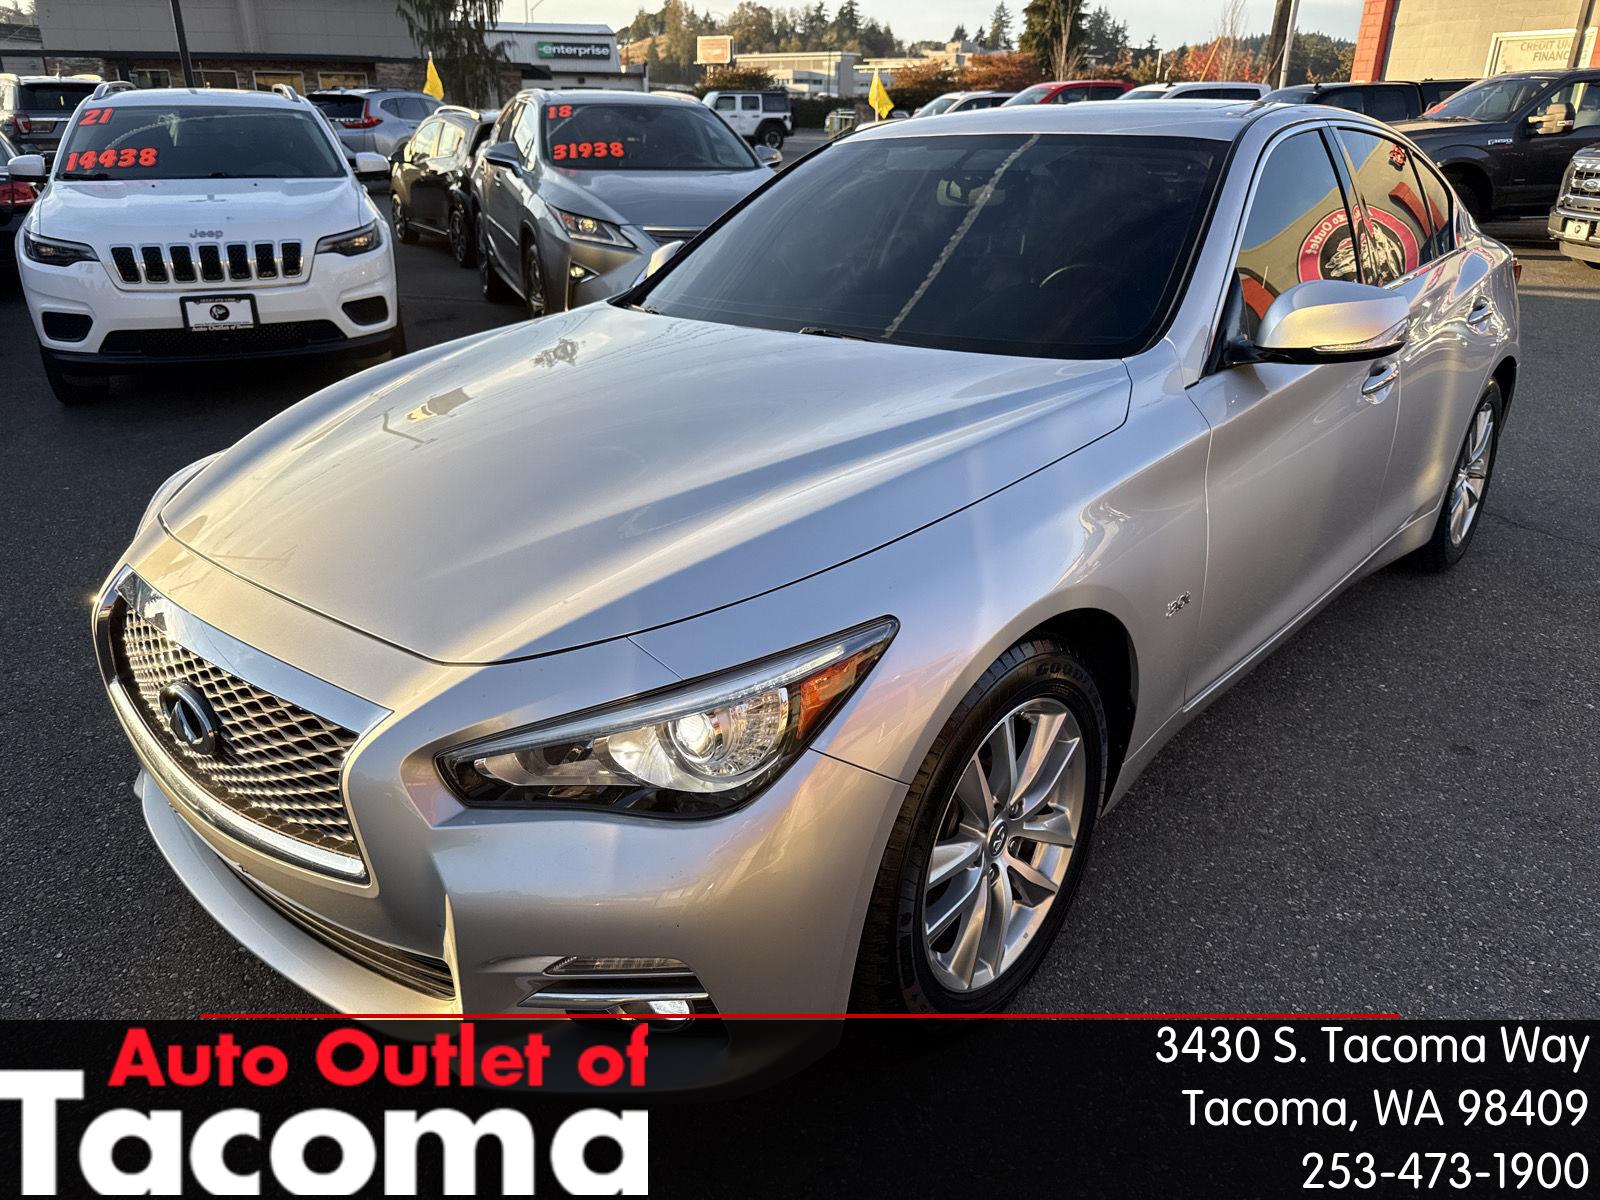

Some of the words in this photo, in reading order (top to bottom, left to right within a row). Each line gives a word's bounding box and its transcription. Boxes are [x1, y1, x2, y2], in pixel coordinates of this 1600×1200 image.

[543, 43, 610, 56] enterprise
[1520, 40, 1556, 51] CREDIT
[1557, 39, 1571, 50] UN
[1533, 50, 1569, 61] FINANC
[79, 108, 113, 126] 21
[548, 105, 573, 119] 18
[553, 142, 624, 160] 31938
[65, 147, 158, 172] 14438
[189, 229, 223, 239] Jeep
